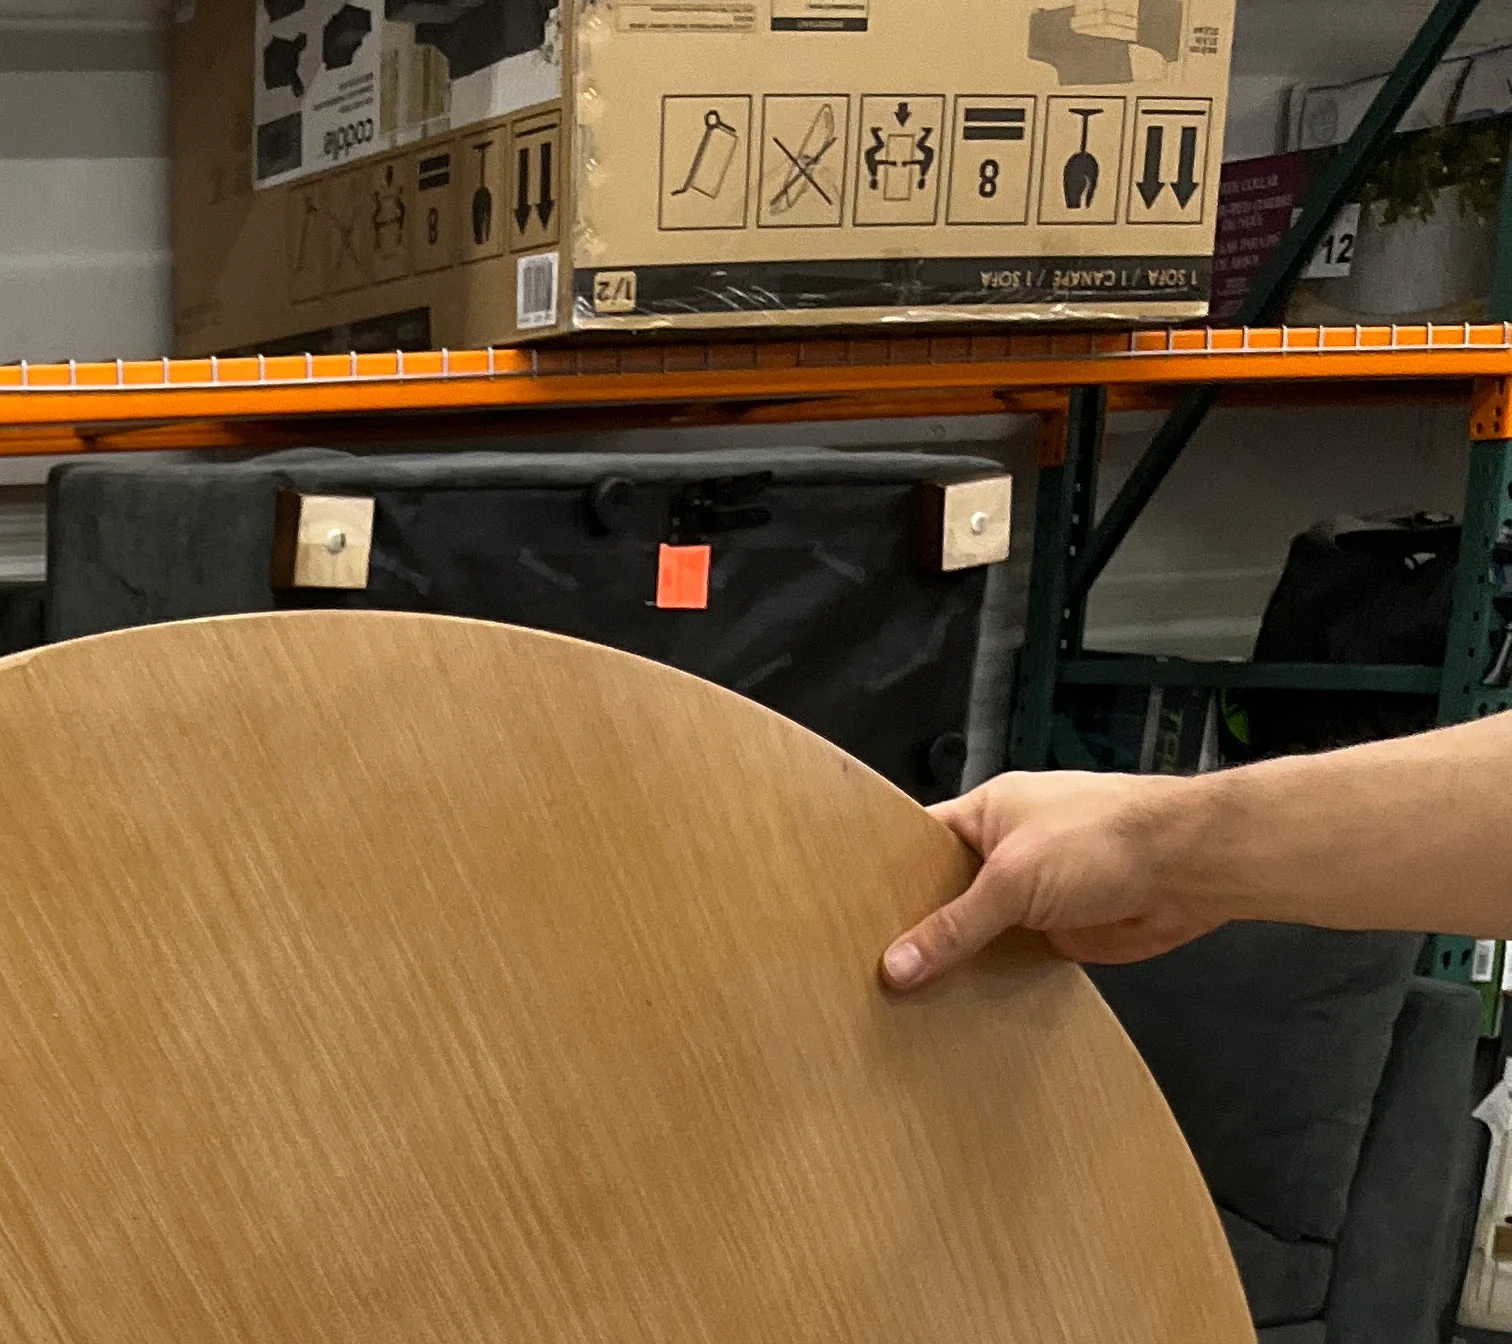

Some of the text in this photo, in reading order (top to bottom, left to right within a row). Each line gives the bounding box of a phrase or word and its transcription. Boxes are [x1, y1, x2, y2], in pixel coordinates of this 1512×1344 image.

[978, 159, 999, 199] 8
[426, 207, 439, 246] 8
[596, 277, 632, 302] 1/2
[1148, 269, 1186, 287] SOFA
